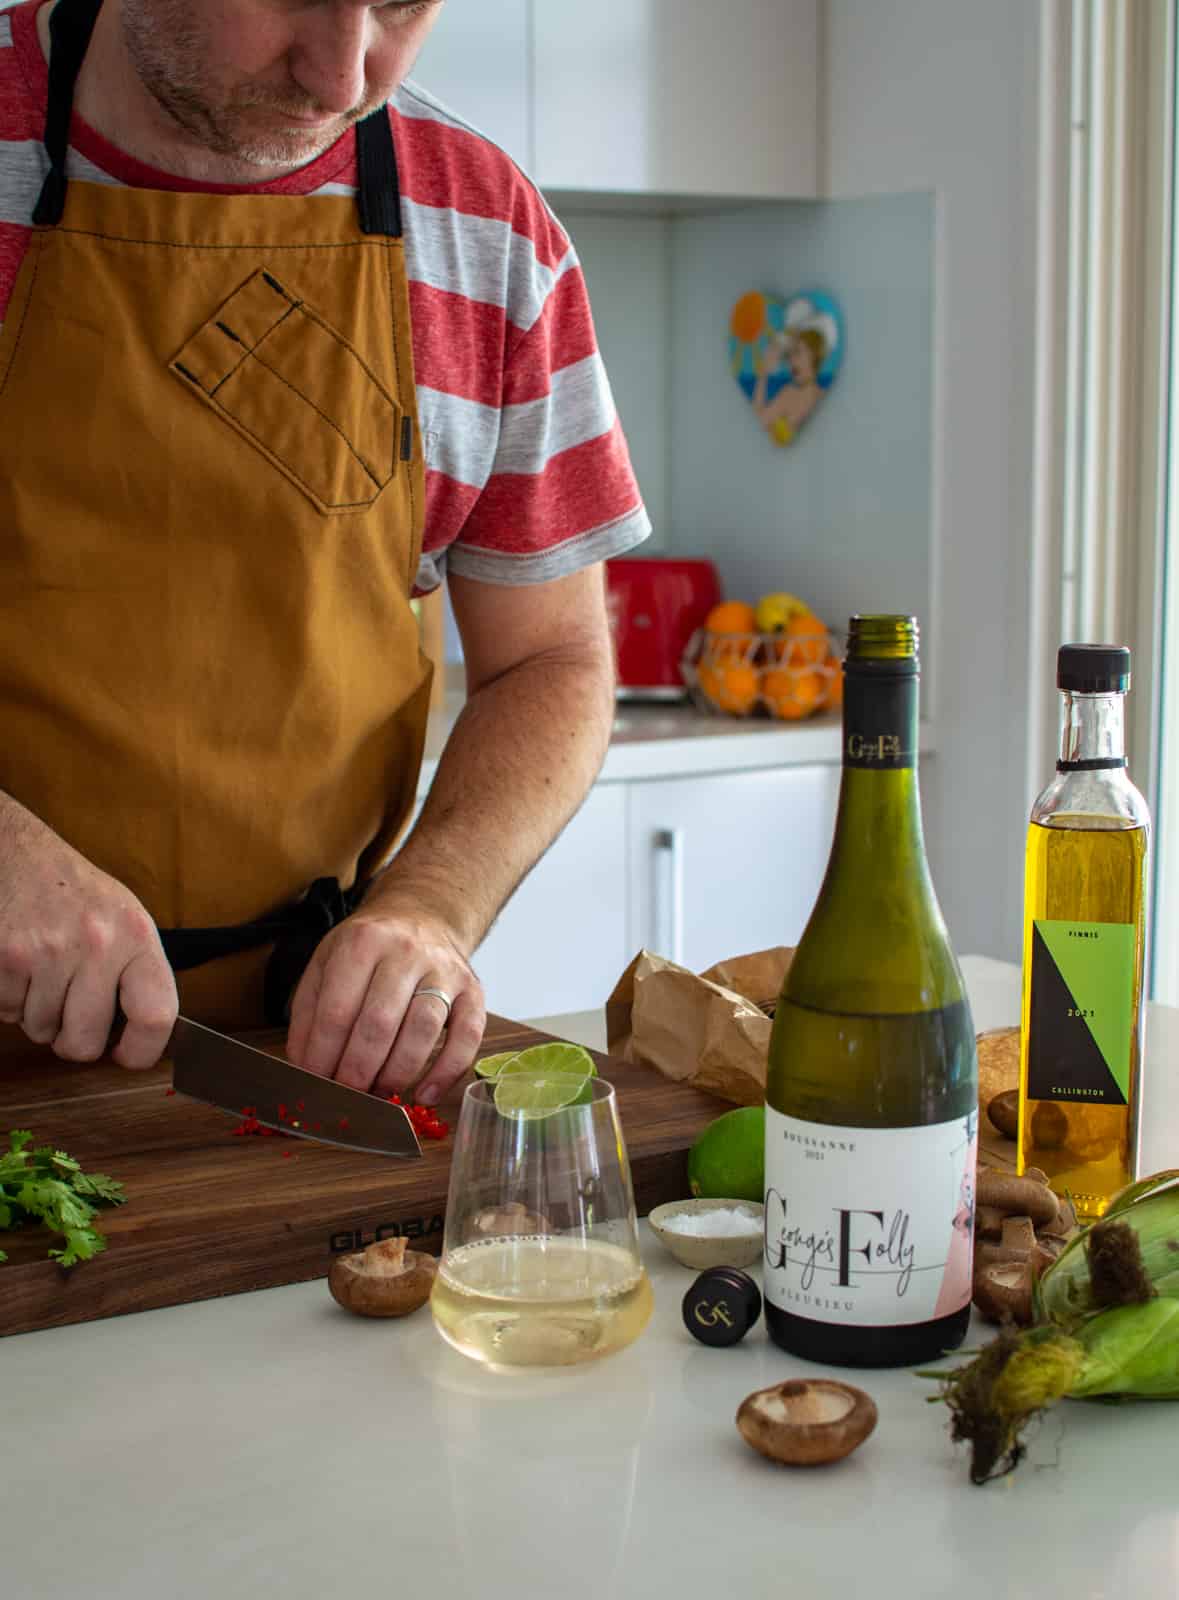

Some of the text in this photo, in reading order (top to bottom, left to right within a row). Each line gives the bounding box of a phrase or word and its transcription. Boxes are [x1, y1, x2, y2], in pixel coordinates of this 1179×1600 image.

[1069, 931, 1099, 939] FINNIS
[1067, 1008, 1095, 1017] 2021
[1051, 1087, 1104, 1096] CALLINGTON
[783, 1129, 856, 1152] ROUSSANNE
[330, 1215, 446, 1251] GLOBA
[833, 1208, 915, 1297] Folly
[781, 1287, 854, 1311] FLEURIEU
